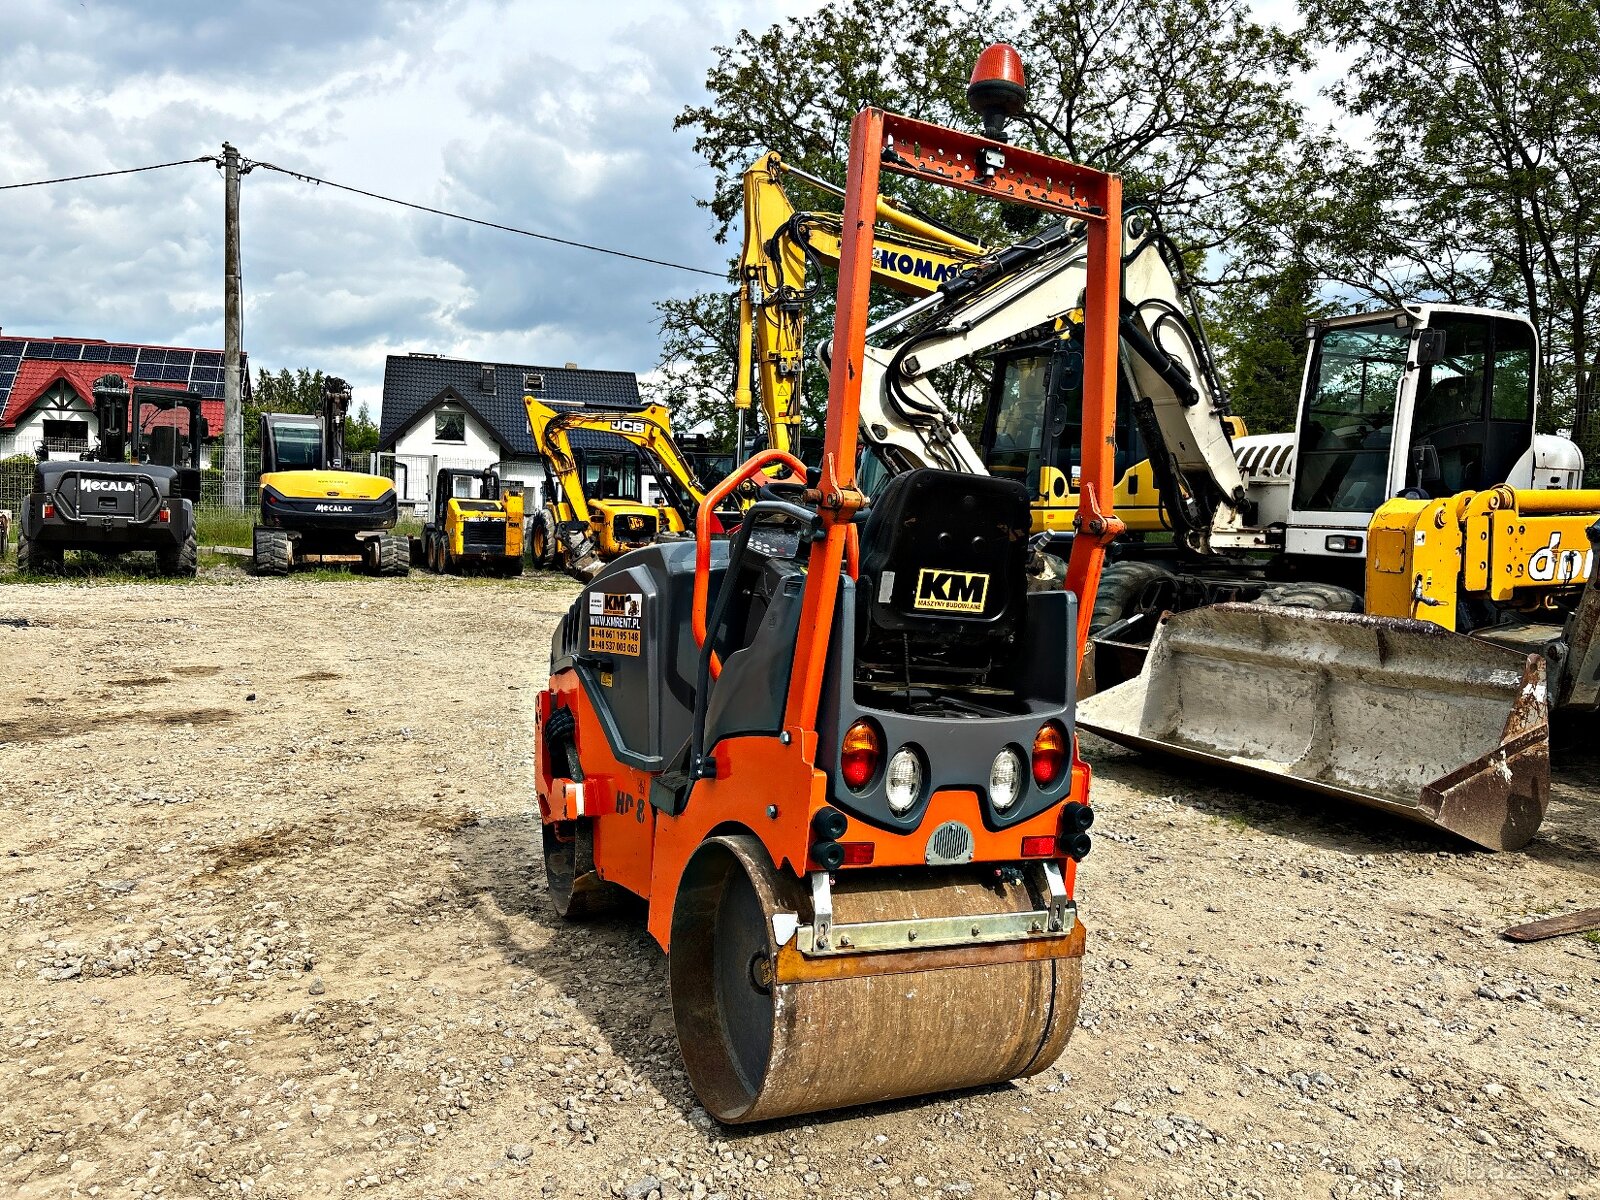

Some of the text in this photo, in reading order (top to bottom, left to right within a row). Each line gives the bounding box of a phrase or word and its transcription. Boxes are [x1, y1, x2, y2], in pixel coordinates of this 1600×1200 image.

[611, 420, 645, 433] JCB
[919, 572, 986, 603] KM
[604, 595, 625, 610] KM
[946, 602, 981, 610] BUDOWLANE
[590, 616, 640, 629] WWW.KMRENT.PL
[605, 641, 616, 651] 537
